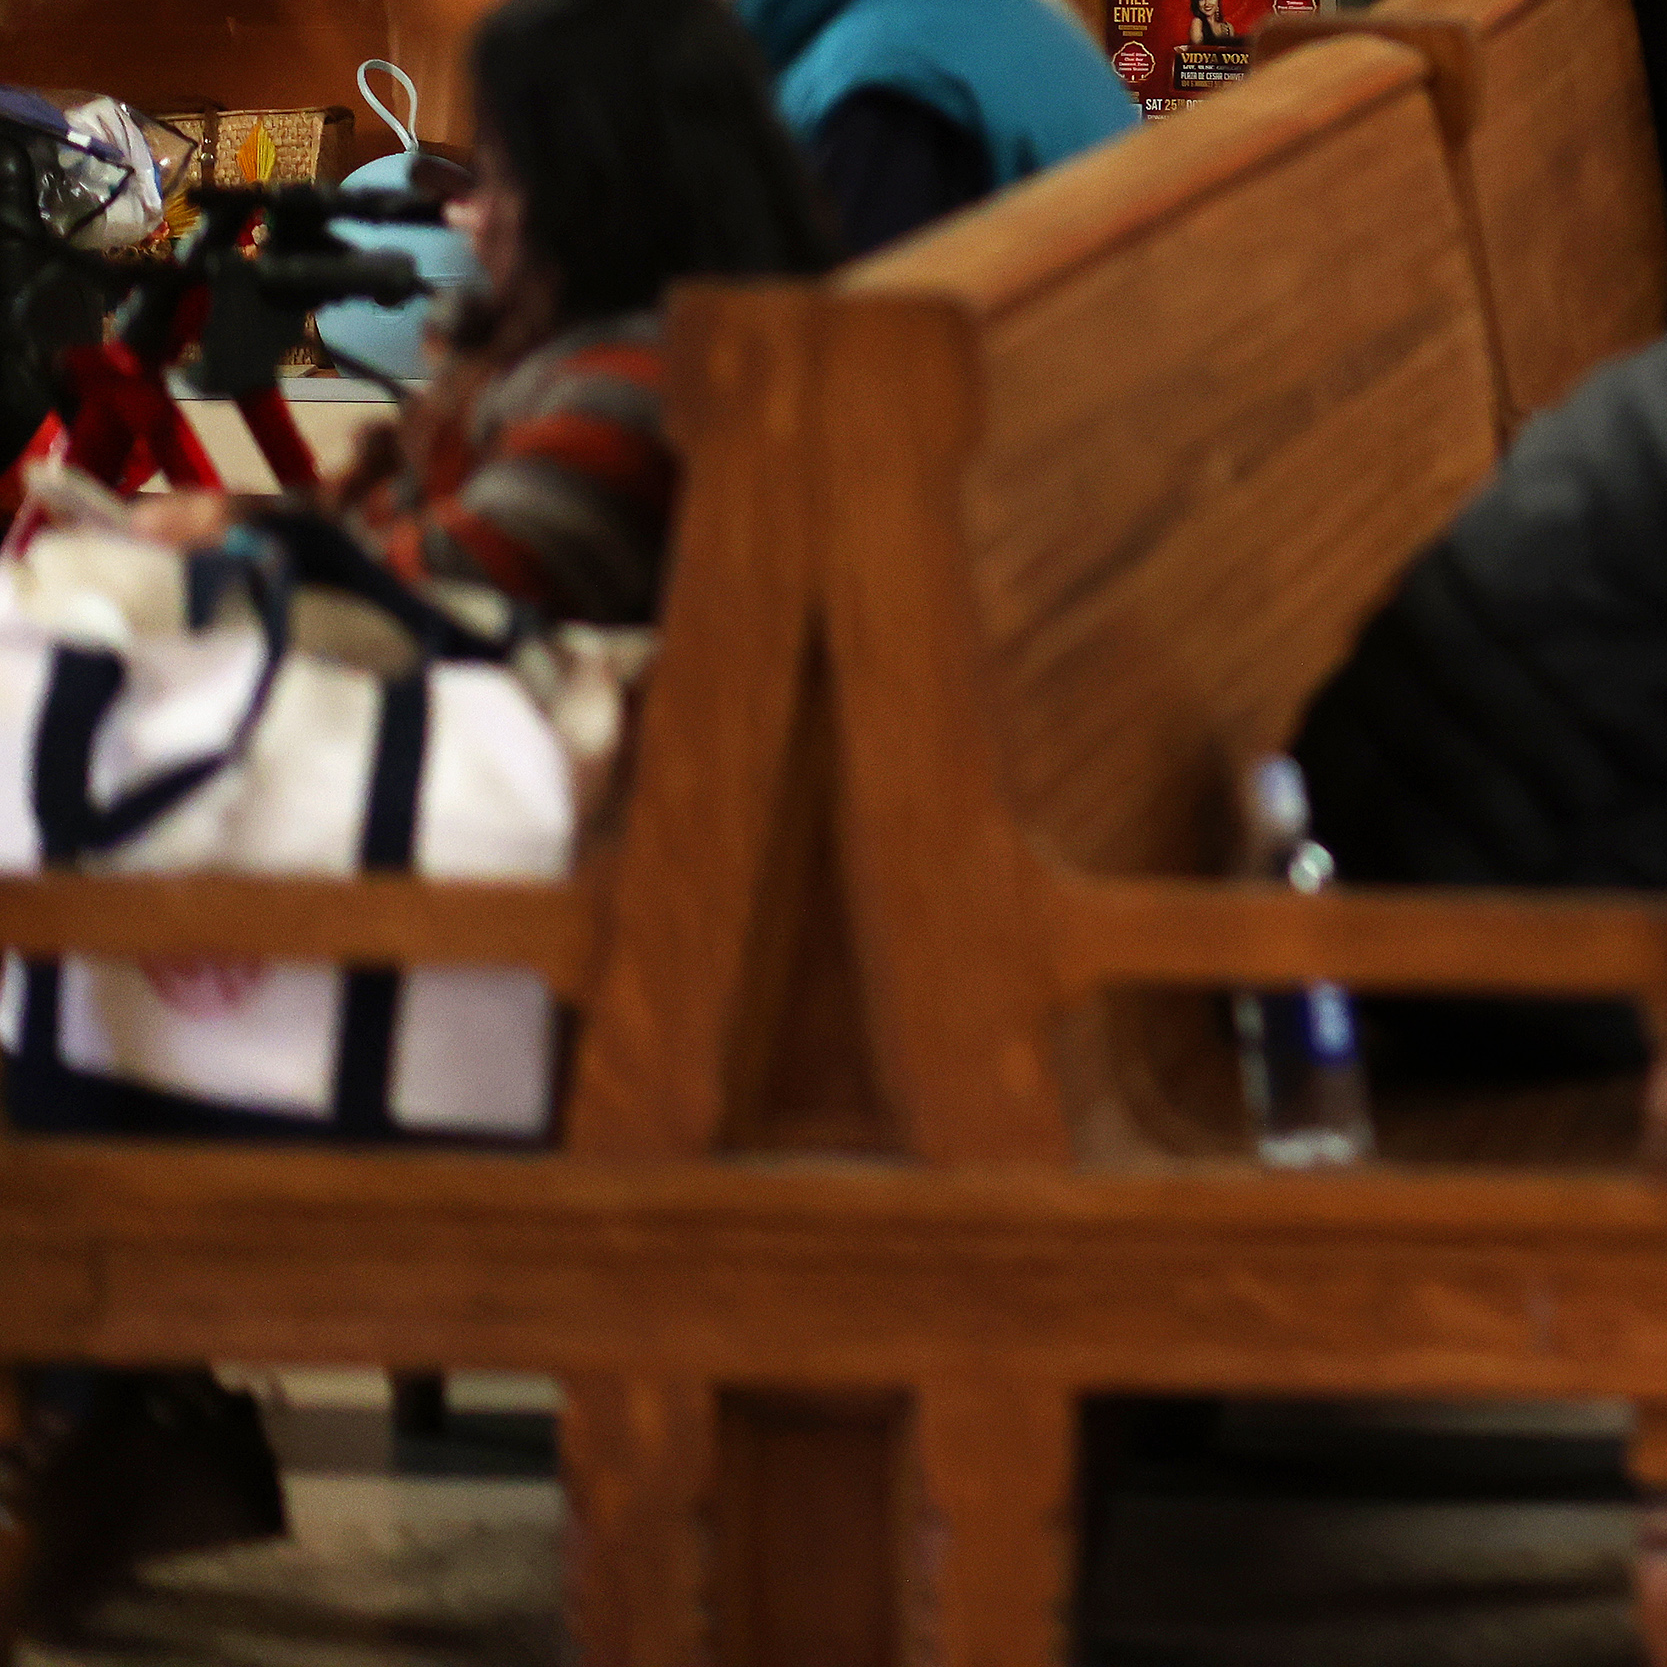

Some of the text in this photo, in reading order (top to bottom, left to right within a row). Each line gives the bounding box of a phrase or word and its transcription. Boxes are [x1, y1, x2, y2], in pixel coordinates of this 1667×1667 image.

[1114, 7, 1153, 23] ENTRY
[1181, 52, 1249, 64] VIDYA VOX
[1206, 72, 1223, 80] CESAR
[1146, 99, 1163, 111] SAT
